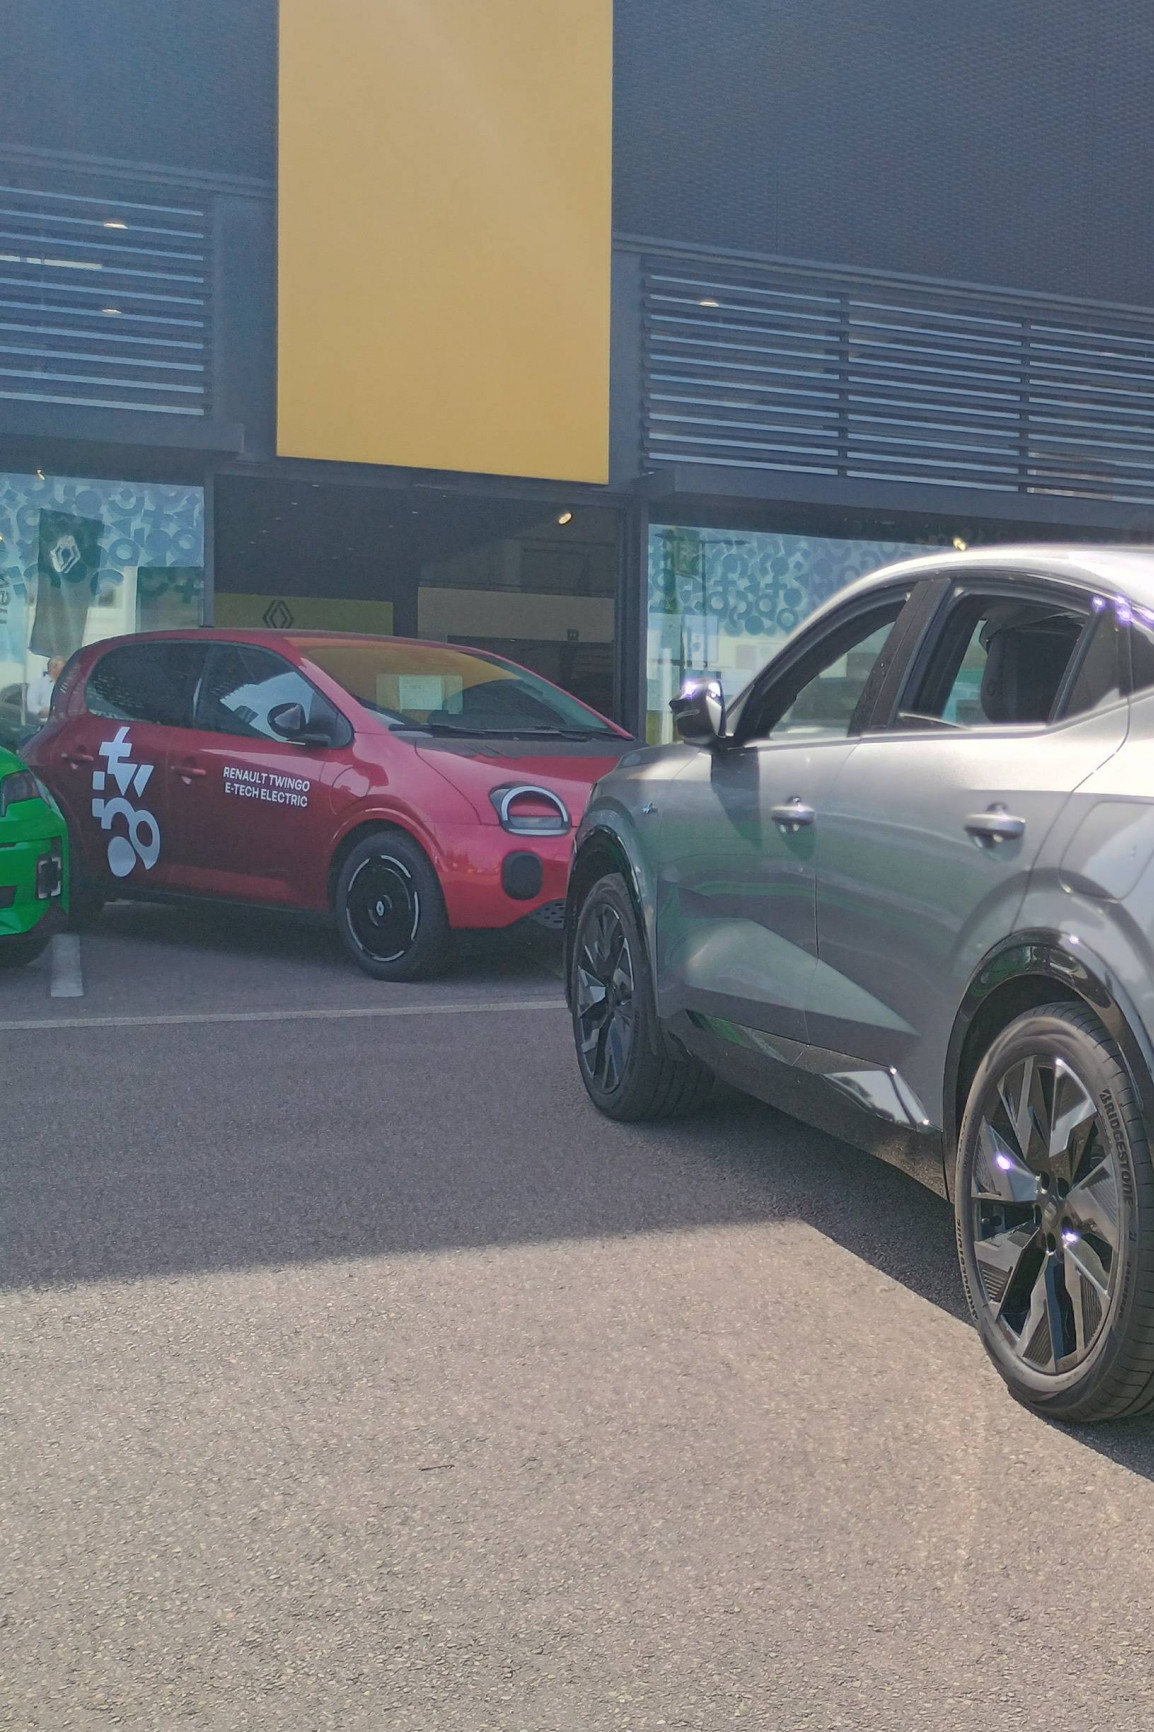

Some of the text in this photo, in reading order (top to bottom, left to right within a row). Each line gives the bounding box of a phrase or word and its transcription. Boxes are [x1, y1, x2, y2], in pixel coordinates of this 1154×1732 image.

[223, 766, 310, 792] RENAULT TWINGO
[224, 782, 308, 808] E-TECH ELECTRIC
[1099, 1088, 1135, 1207] BRIDGESTONE
